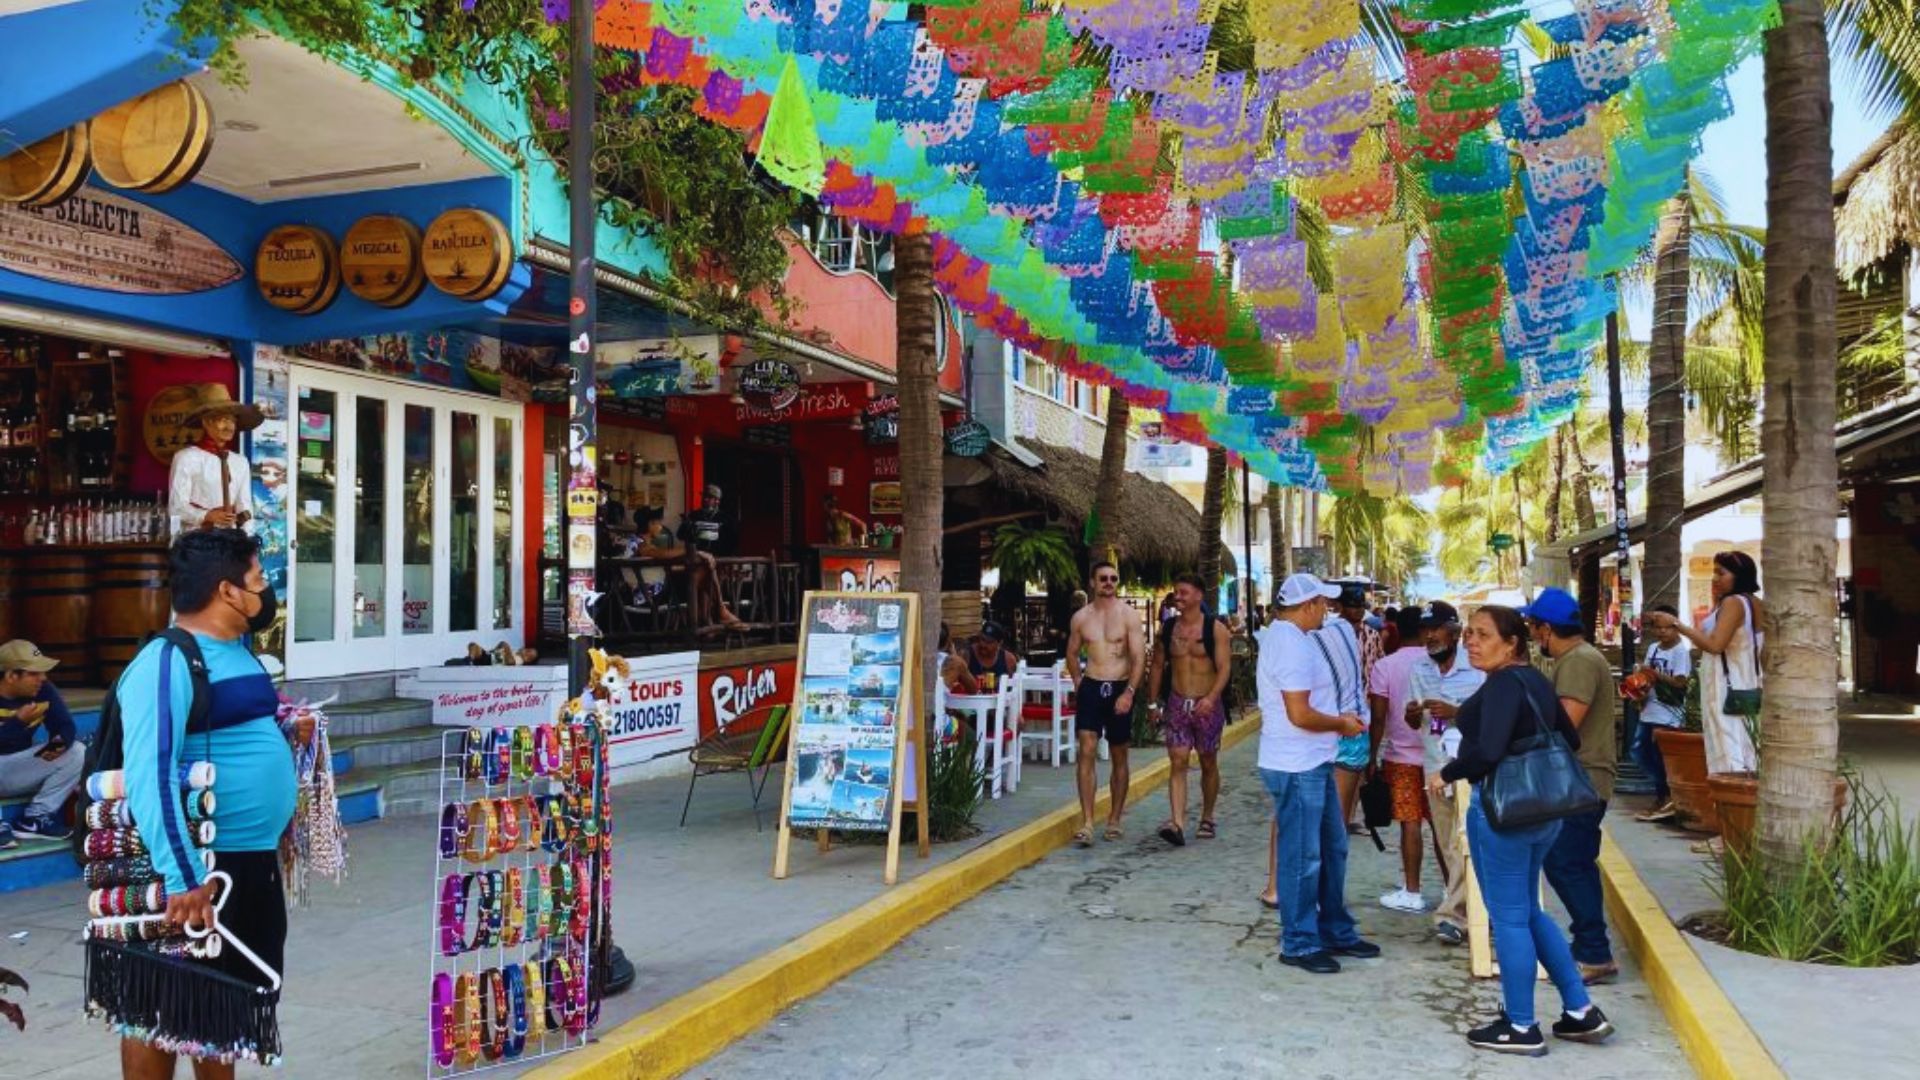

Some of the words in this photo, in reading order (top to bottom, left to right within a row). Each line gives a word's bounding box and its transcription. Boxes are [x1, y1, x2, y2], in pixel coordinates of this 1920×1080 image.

[56, 196, 141, 238] SELECTA
[352, 242, 402, 255] MEZCAL
[432, 235, 487, 251] RAICILLA
[266, 250, 316, 262] TEQUILA
[438, 693, 478, 707] Welcome
[480, 689, 490, 701] to
[492, 686, 508, 699] the
[510, 683, 533, 697] best
[628, 679, 684, 702] tours
[711, 667, 777, 734] Ruben
[464, 706, 485, 720] day
[486, 703, 498, 715] of
[498, 699, 522, 716] your
